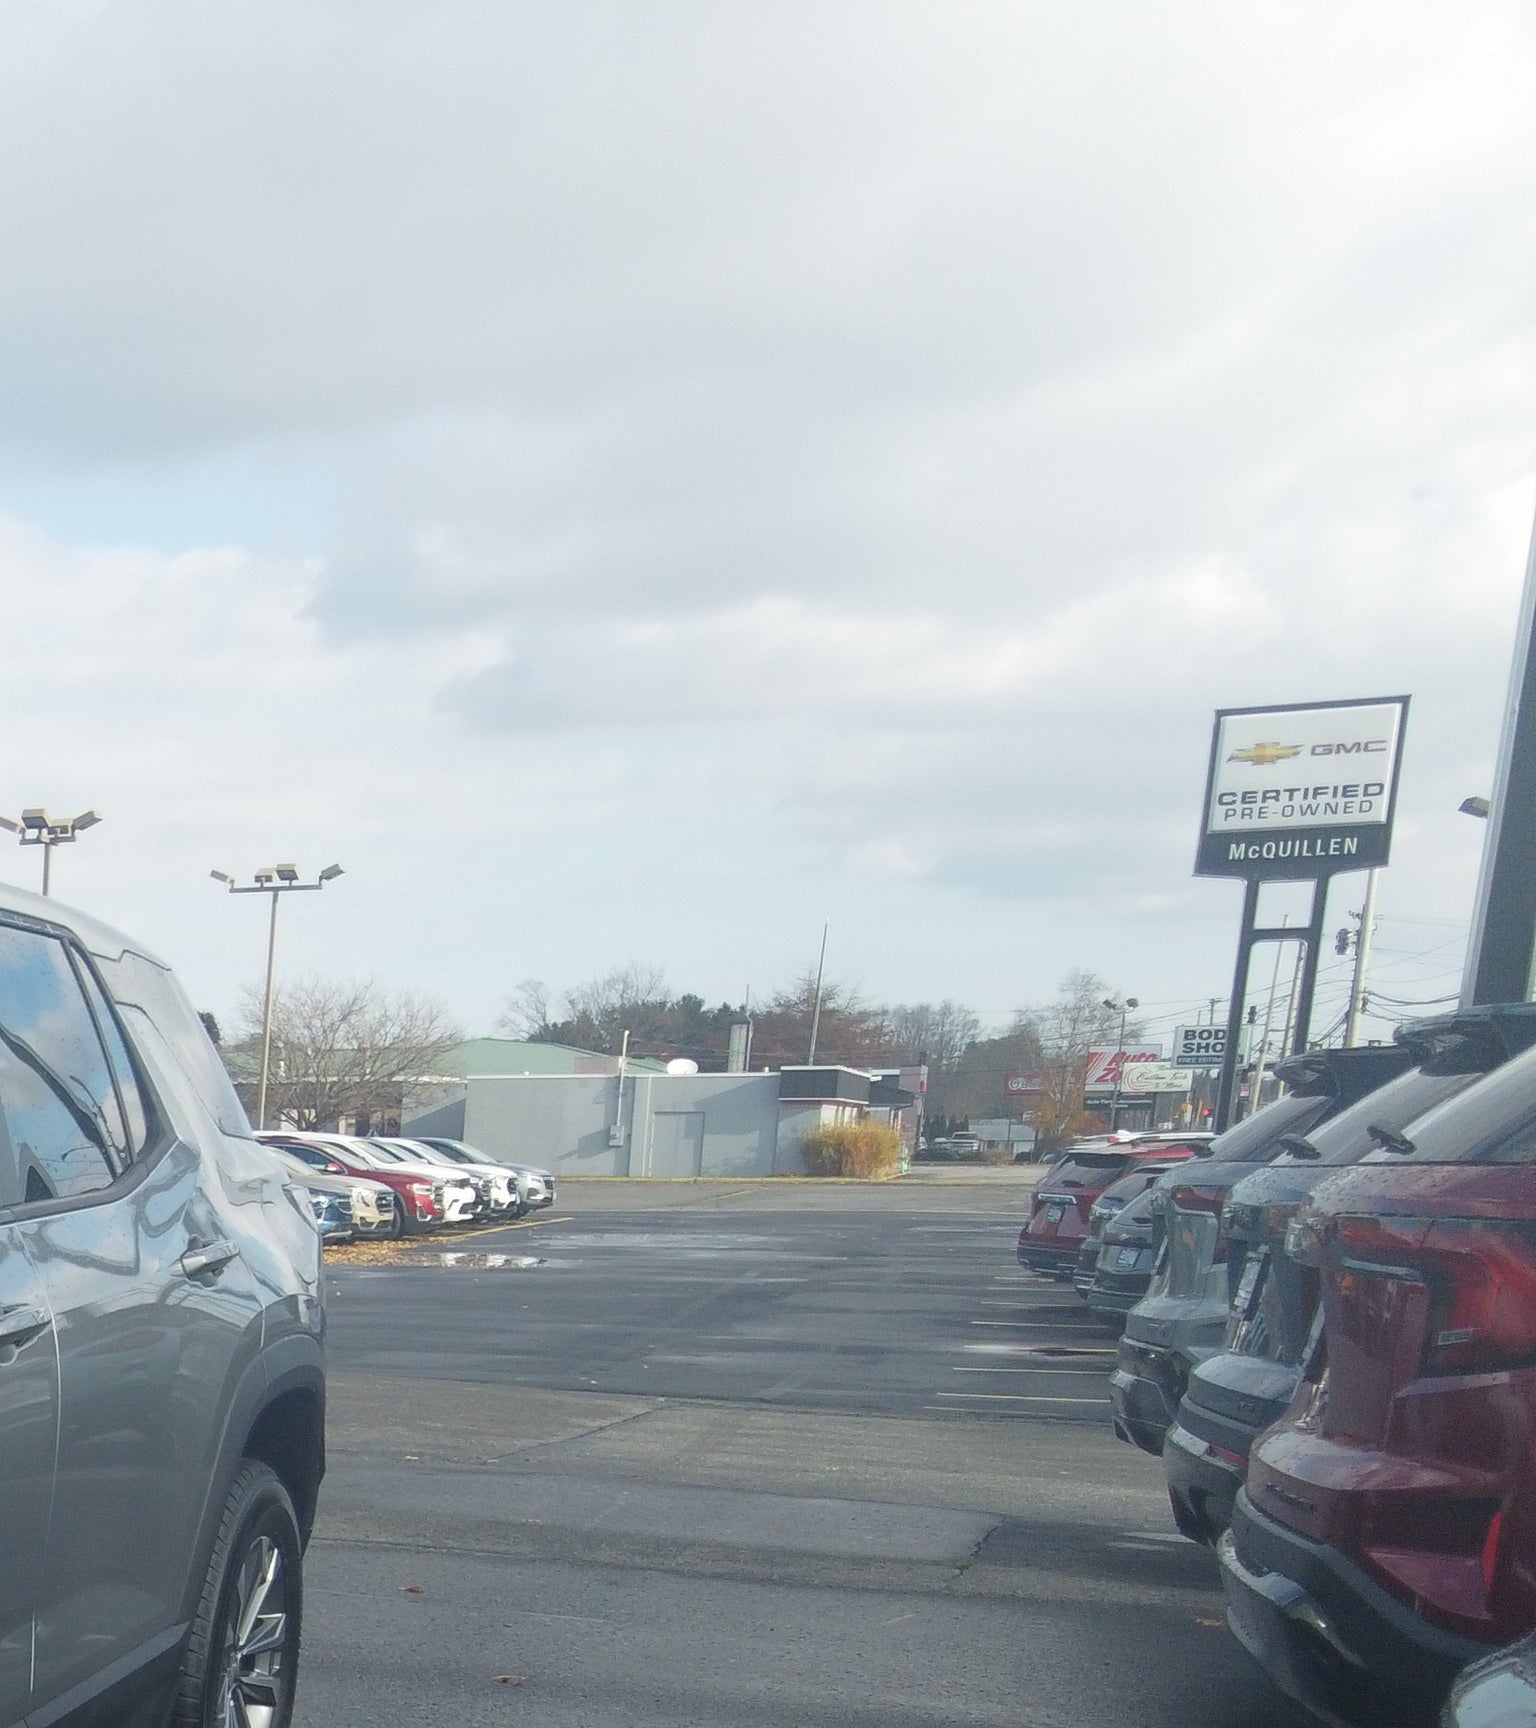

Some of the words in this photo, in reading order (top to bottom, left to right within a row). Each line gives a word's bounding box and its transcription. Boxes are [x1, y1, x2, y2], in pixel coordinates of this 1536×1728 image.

[1310, 740, 1387, 757] GMC
[1218, 782, 1385, 807] CERTIFIED
[1224, 800, 1373, 822] PRE-OWNED
[1228, 837, 1358, 861] McQUILLEN
[1184, 1029, 1226, 1041] BOD
[1182, 1041, 1226, 1054] SHO
